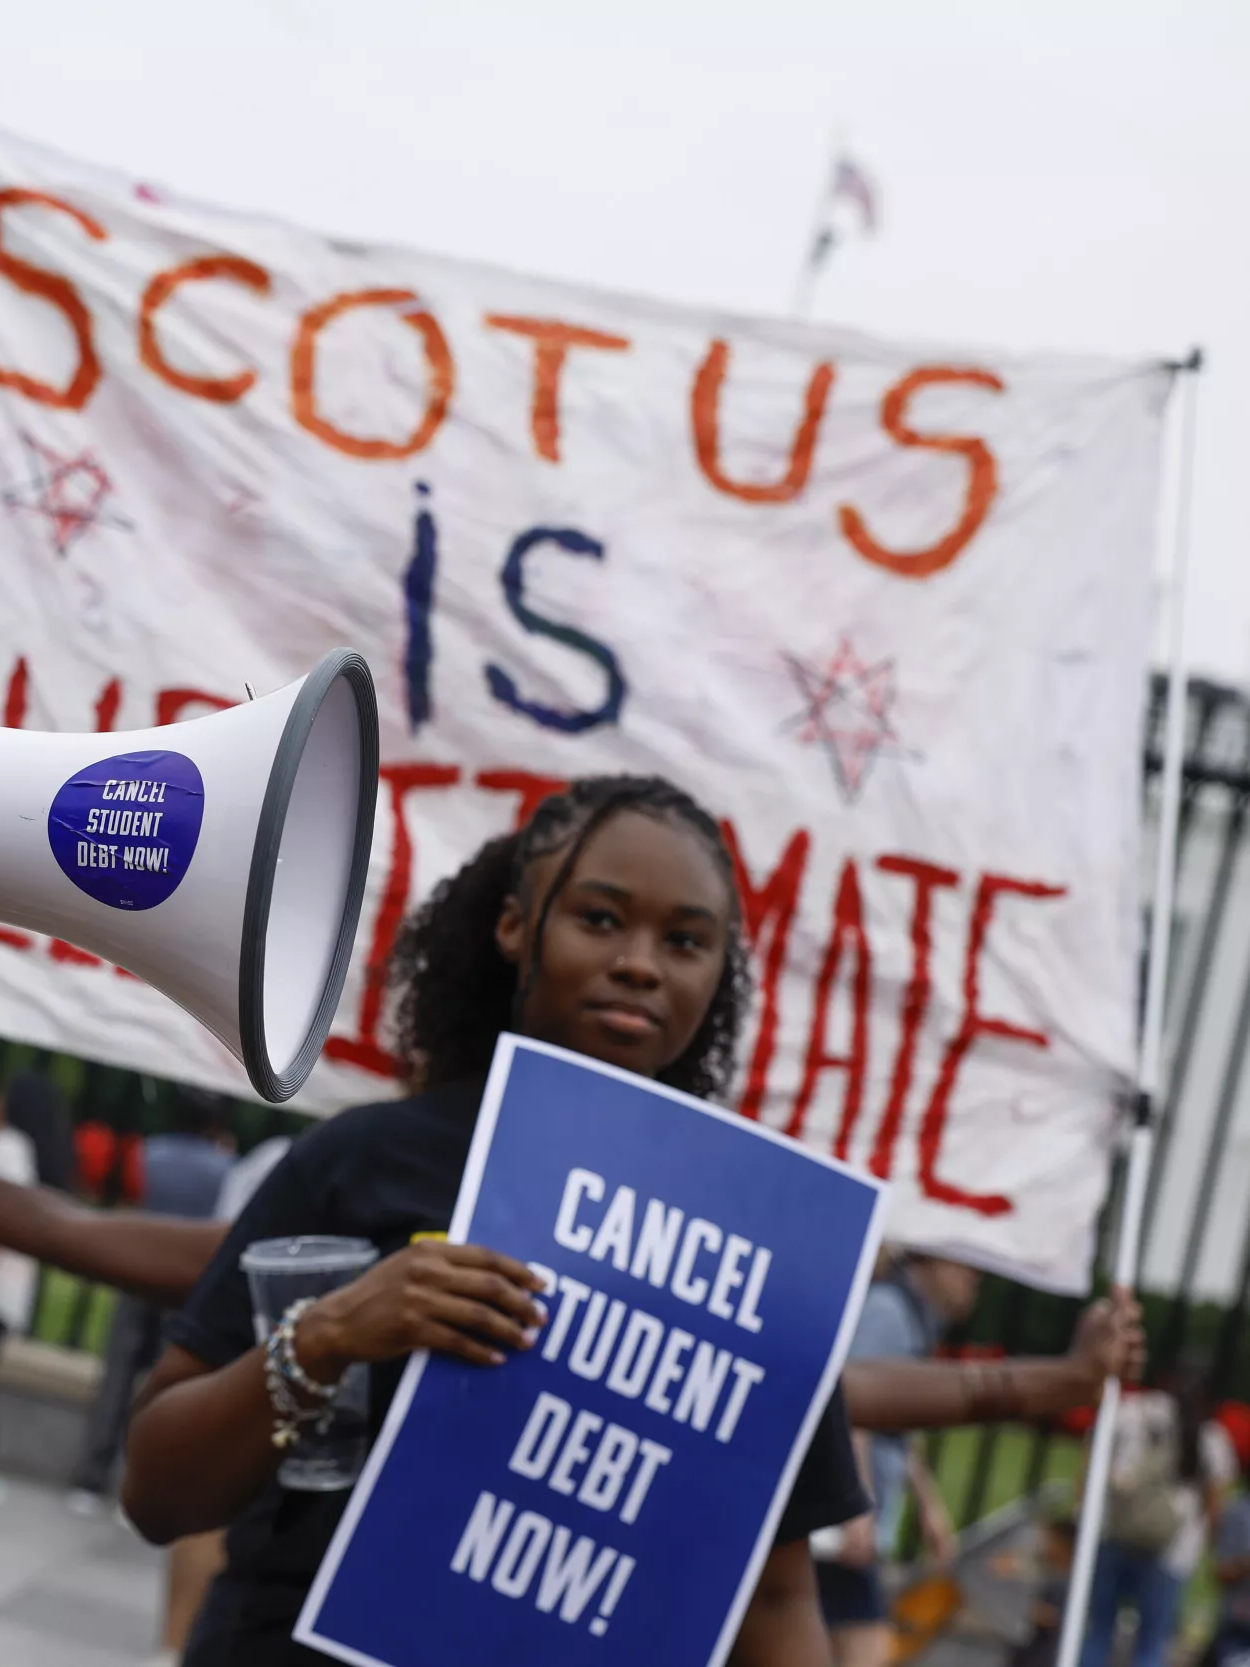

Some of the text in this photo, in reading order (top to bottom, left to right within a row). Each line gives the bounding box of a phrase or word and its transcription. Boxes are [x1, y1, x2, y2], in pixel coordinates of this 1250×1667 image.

[86, 808, 163, 837] STUDENT
[102, 779, 167, 803] CANCEL
[77, 841, 169, 874] DEBT NOW!
[553, 1167, 772, 1333] CANCEL
[508, 1391, 672, 1526] DEBT
[450, 1490, 636, 1637] NOW!
